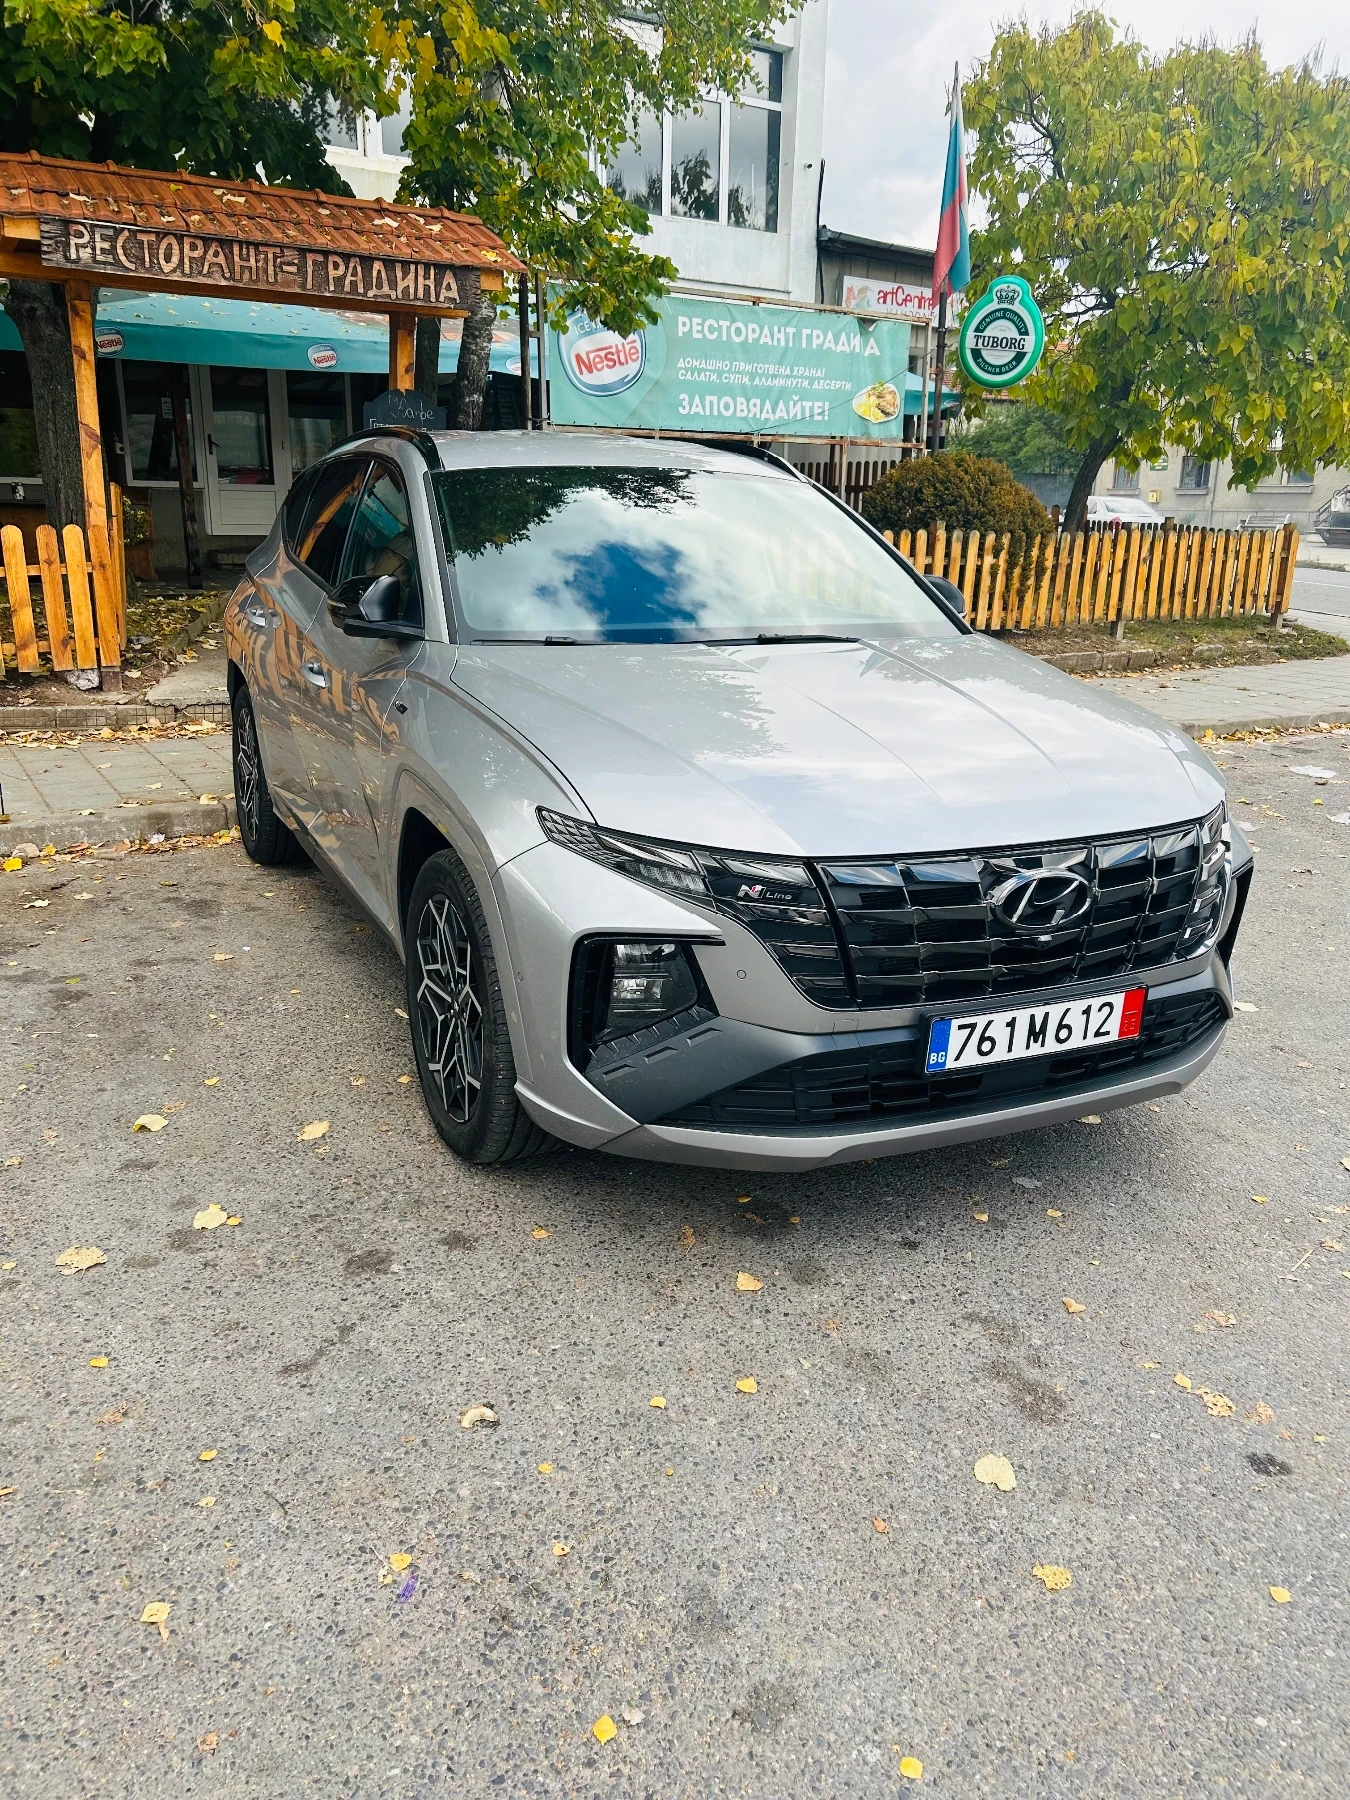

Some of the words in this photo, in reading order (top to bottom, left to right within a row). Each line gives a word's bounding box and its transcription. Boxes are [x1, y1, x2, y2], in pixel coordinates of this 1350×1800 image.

[574, 320, 592, 336] ICE
[980, 310, 1004, 330] GENUINE
[1005, 311, 1026, 333] QUALITY
[677, 315, 797, 347] РЕСТОРАНТ
[801, 328, 881, 357] ГРАДИА
[973, 334, 1026, 351] TUBORG
[677, 357, 730, 371] ДОМАШНО
[732, 361, 791, 375] ПРИГОТВЕНА
[793, 366, 825, 378] ХРАНА!
[976, 358, 1000, 373] PILSNER
[1001, 360, 1018, 373] BEER
[678, 369, 719, 383] САЛАТИ,
[722, 373, 751, 386] СУПИ,
[812, 380, 852, 391] ДЕСЕРТИ
[678, 393, 830, 421] ЗАПОВЯДАЙТЕ!
[766, 891, 792, 900] Line
[929, 1051, 946, 1065] BG
[953, 1001, 1115, 1062] 761M612
